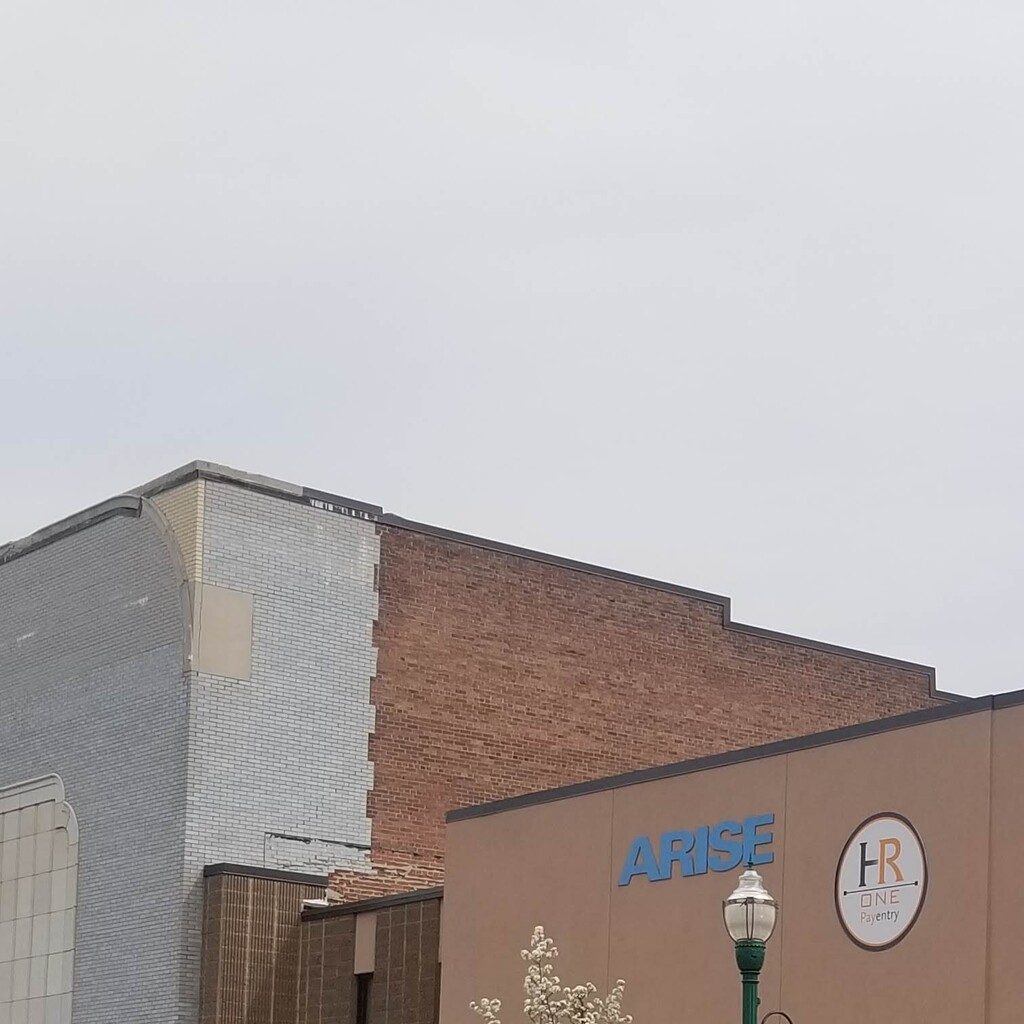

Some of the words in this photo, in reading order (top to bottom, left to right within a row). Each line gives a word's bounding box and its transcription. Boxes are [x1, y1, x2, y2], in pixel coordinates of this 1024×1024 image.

[618, 813, 775, 887] ARISE
[858, 837, 905, 888] HR
[860, 889, 901, 908] ONE
[860, 910, 900, 926] Payentry
